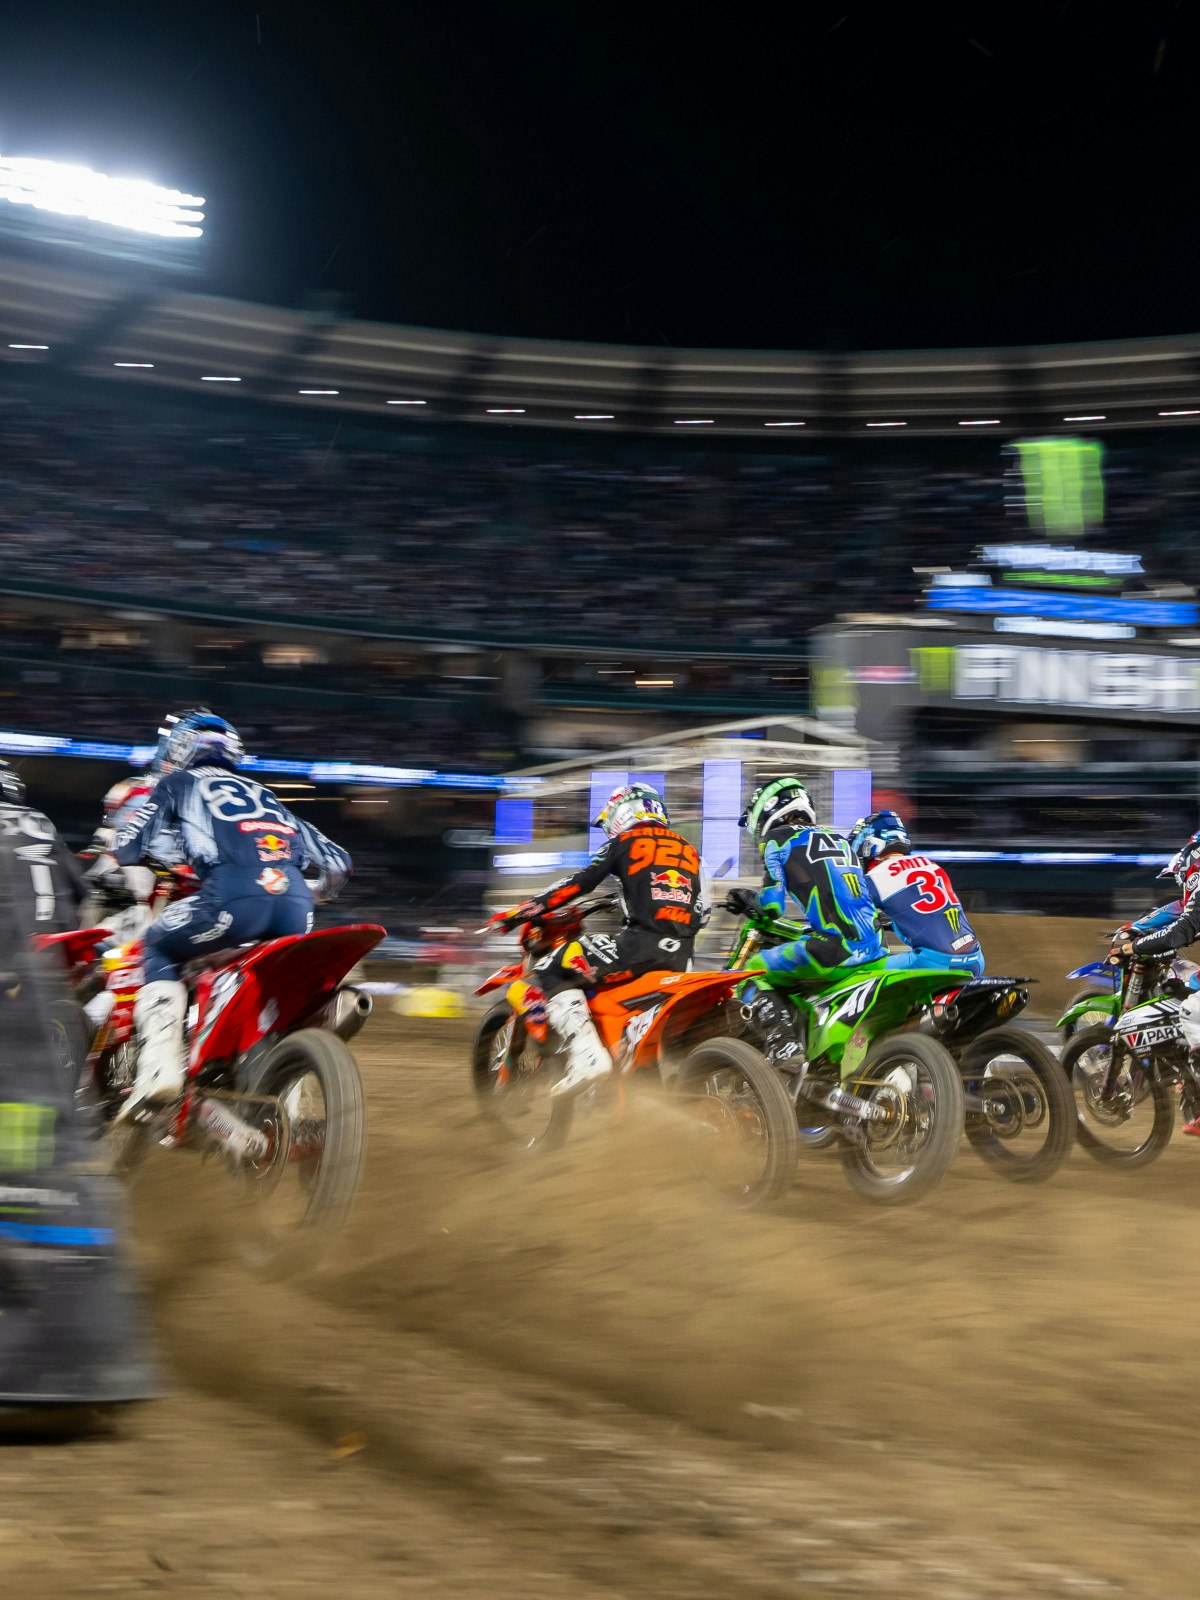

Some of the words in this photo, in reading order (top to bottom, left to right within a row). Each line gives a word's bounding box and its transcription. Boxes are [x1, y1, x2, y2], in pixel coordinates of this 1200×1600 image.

[628, 838, 700, 875] 929
[806, 831, 860, 868] 47
[888, 856, 935, 877] SMIT
